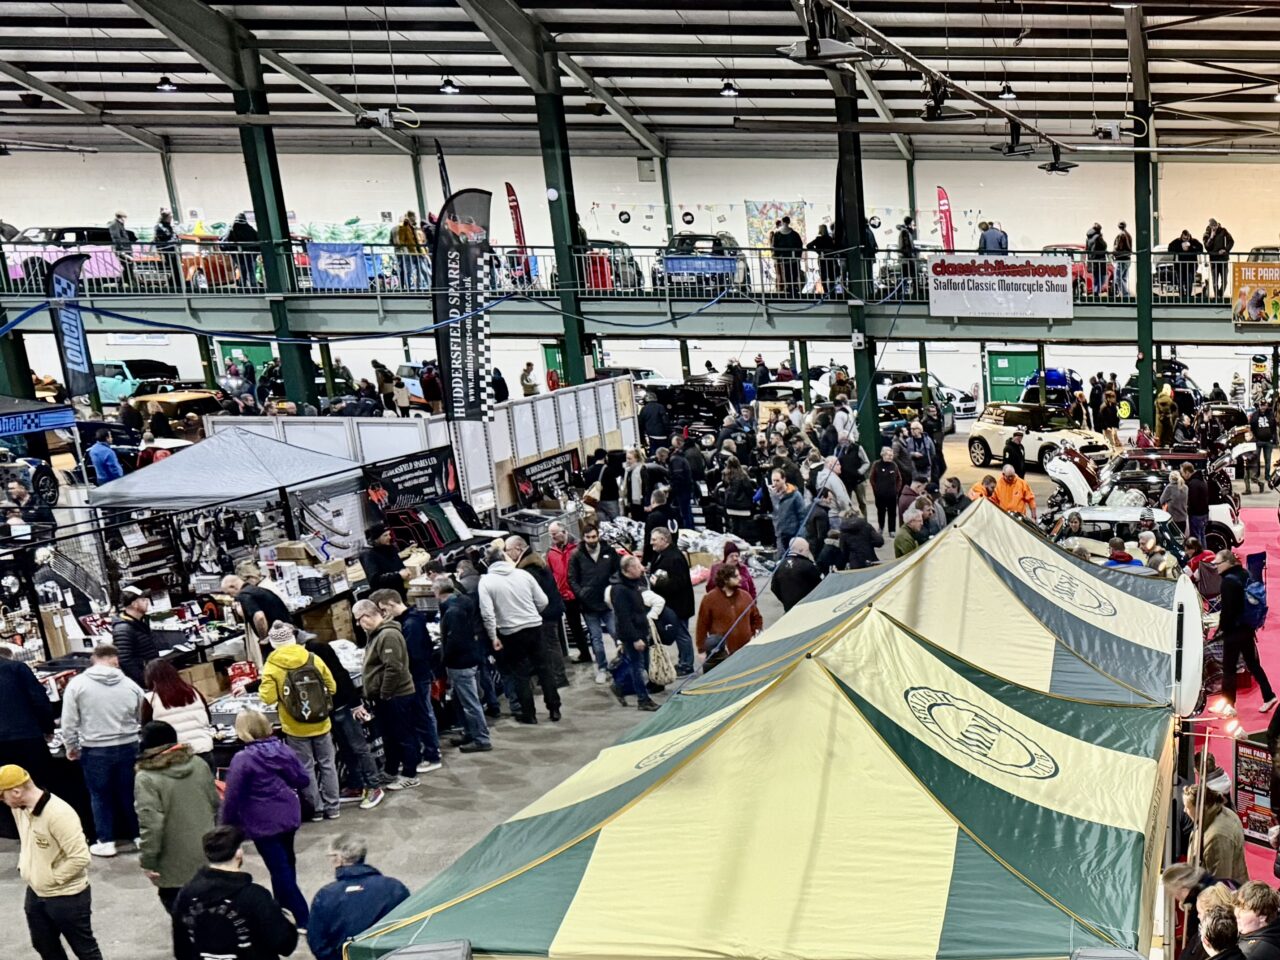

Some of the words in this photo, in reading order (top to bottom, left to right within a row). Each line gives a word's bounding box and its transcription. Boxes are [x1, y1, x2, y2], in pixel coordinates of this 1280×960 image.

[932, 259, 1068, 277] classicbikeshows
[1241, 268, 1256, 280] THE
[448, 251, 461, 305] SPARES
[933, 279, 965, 291] Stafford
[967, 280, 996, 291] Classic
[998, 280, 1043, 294] Motorcycle
[1045, 280, 1068, 293] Show
[449, 314, 466, 418] HUDDERSFIELD
[956, 713, 1002, 758] MINI
[1238, 746, 1253, 755] MINI
[1253, 749, 1267, 759] FAIR
